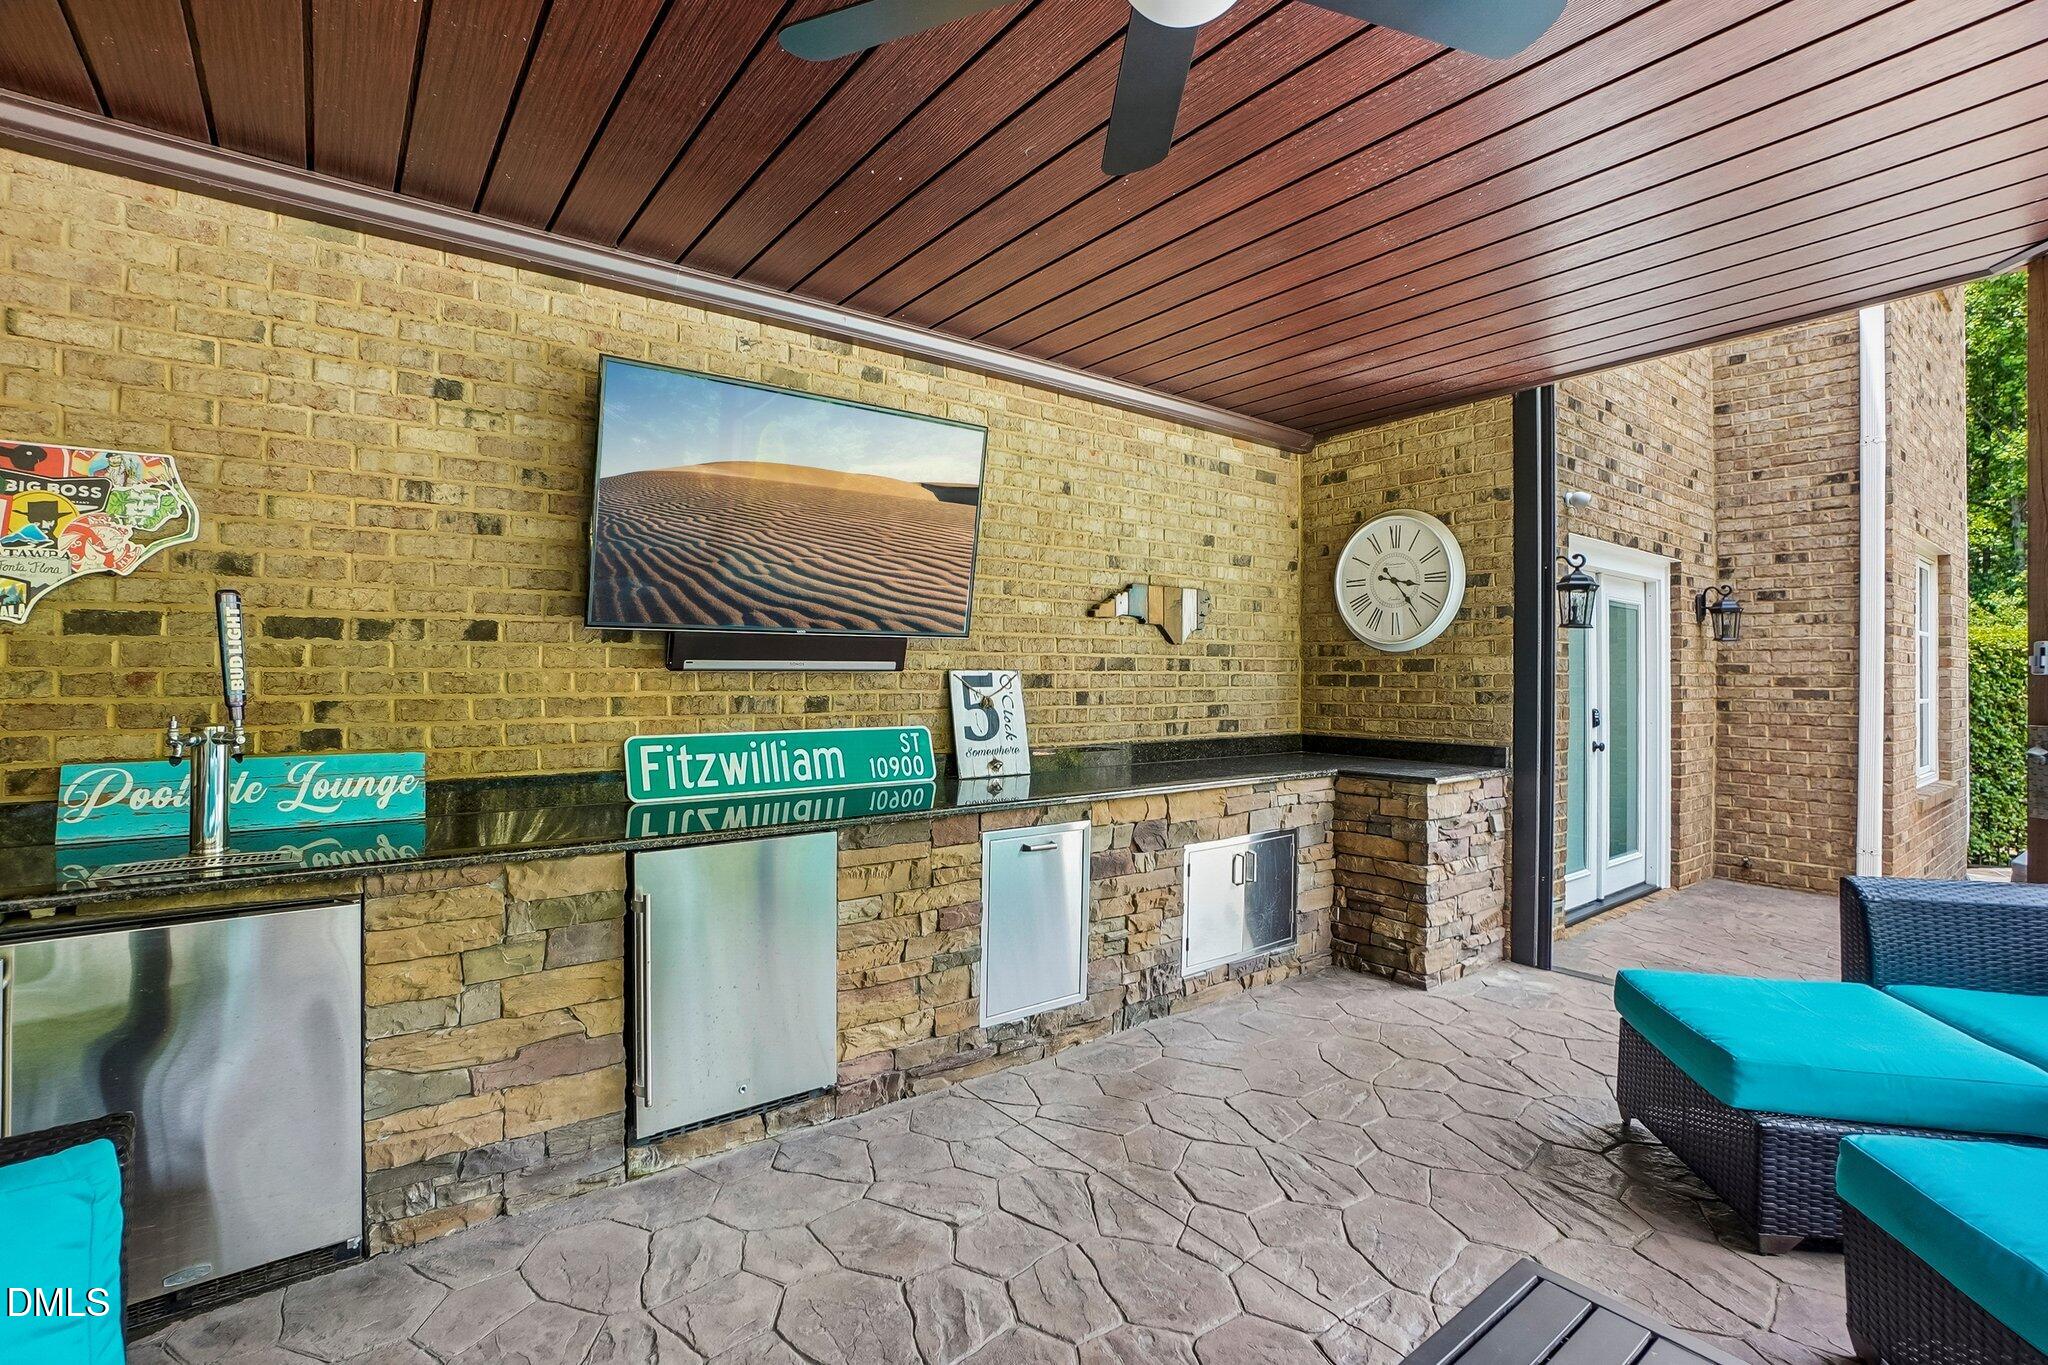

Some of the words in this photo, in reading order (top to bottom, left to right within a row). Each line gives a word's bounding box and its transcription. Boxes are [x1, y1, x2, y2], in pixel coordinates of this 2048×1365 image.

[5, 479, 41, 492] BIG
[47, 483, 102, 498] BOSS
[28, 561, 63, 575] Flora
[226, 606, 243, 655] LIGHT
[229, 655, 245, 691] BUD
[961, 672, 1000, 741] 5
[899, 732, 921, 753] ST
[965, 745, 1020, 758] Somewhere
[639, 739, 847, 792] Fitzwilliam
[869, 755, 925, 779] 10900
[63, 767, 268, 824] Poolde
[276, 761, 420, 813] Lounge
